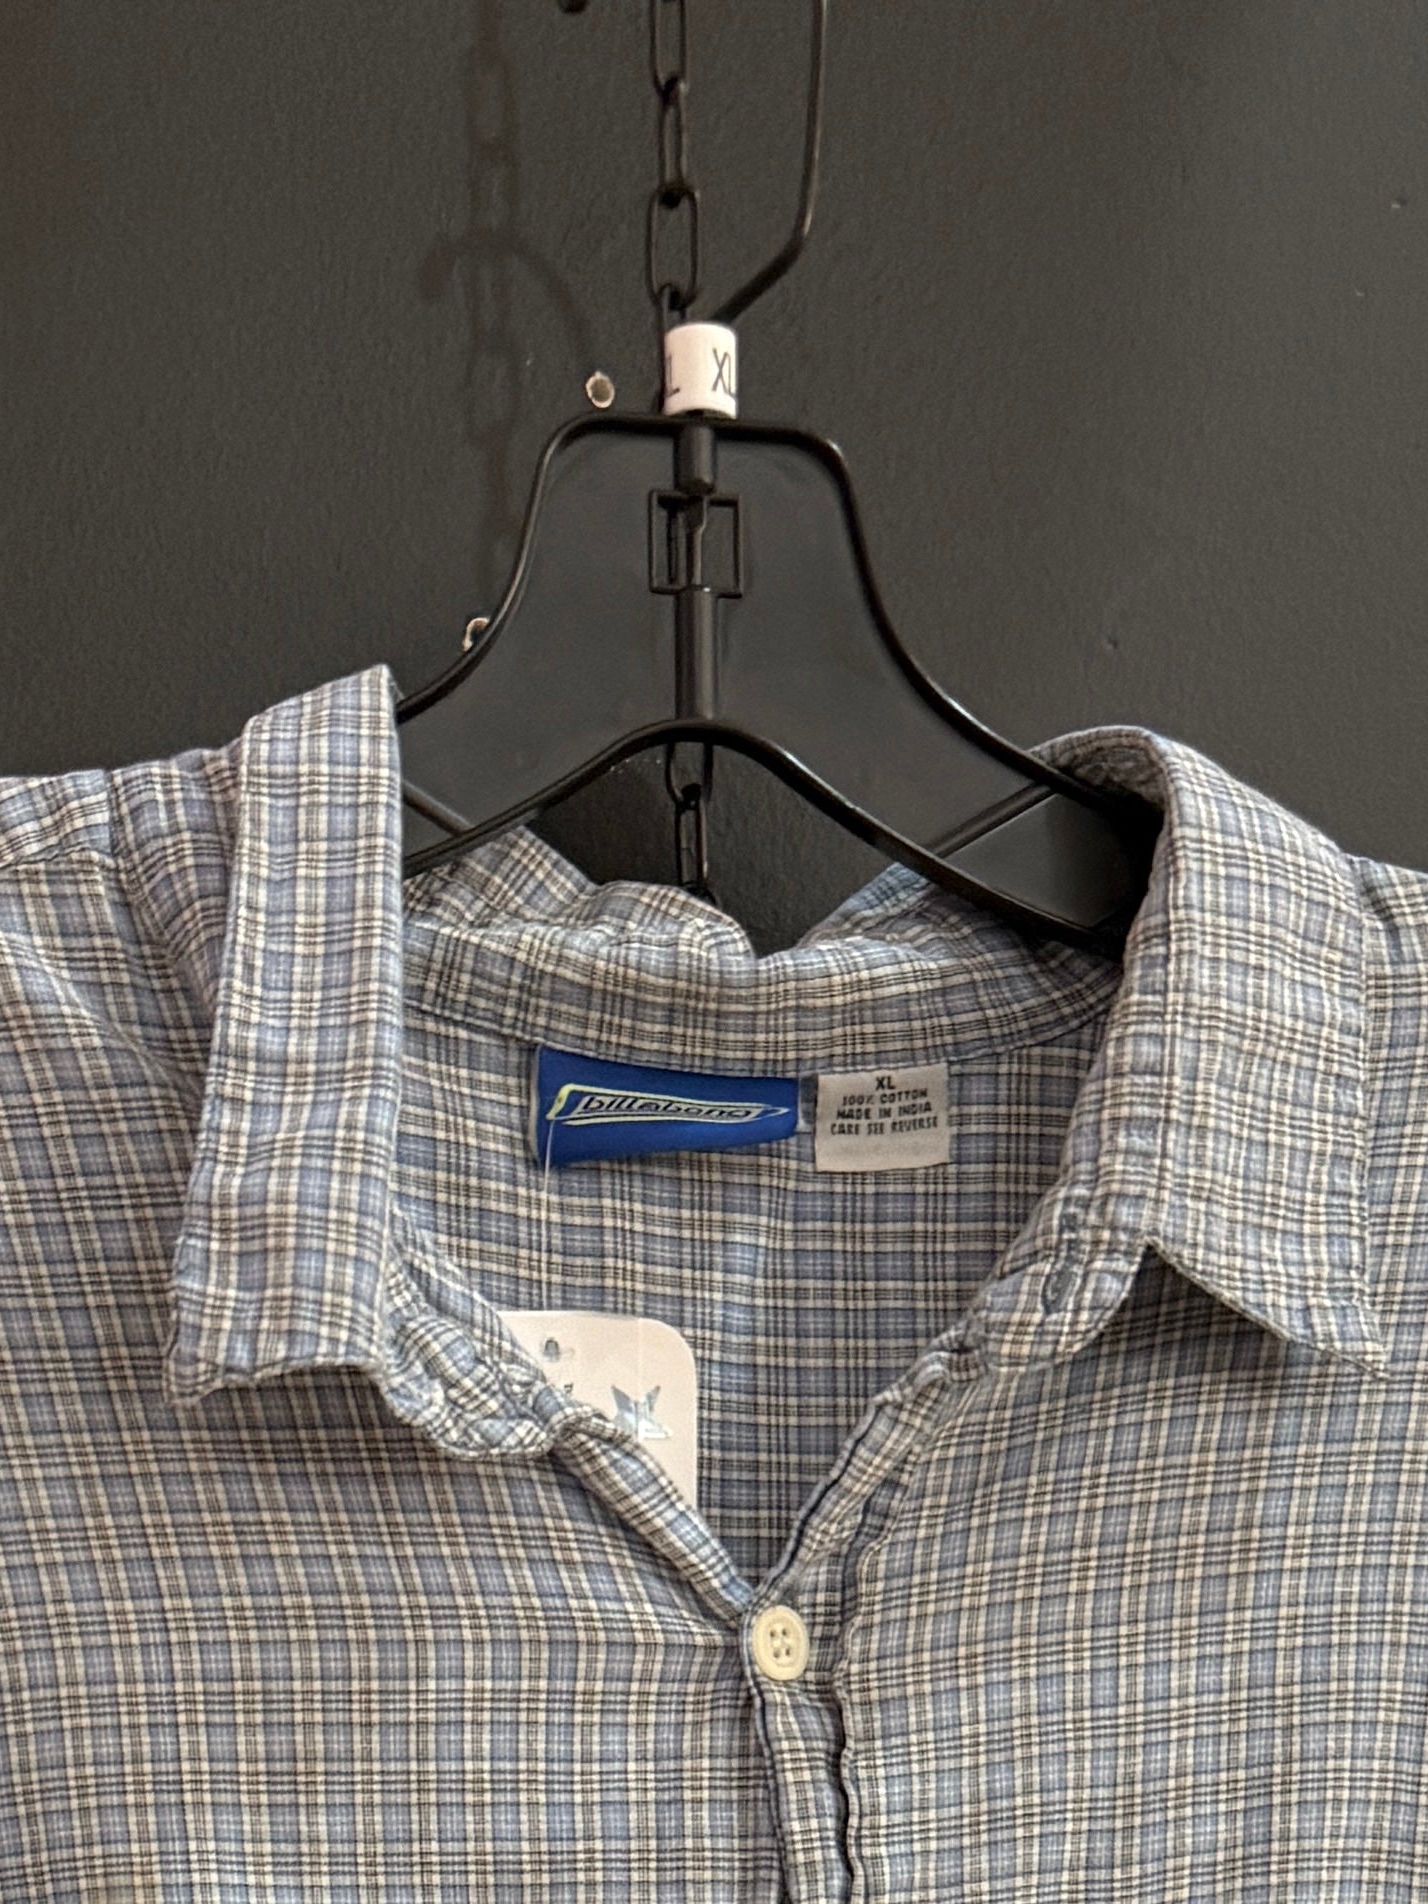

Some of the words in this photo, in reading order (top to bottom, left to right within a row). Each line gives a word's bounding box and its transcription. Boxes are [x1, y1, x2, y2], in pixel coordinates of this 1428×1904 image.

[875, 1076, 896, 1091] XL
[842, 1094, 873, 1107] 100%
[880, 1088, 928, 1104] COTTON
[836, 1107, 871, 1120] MADE
[879, 1107, 892, 1119] IN
[898, 1101, 932, 1116] INDIA
[830, 1122, 860, 1136] CARE
[867, 1122, 885, 1135] SEE
[891, 1116, 938, 1134] REVERSE
